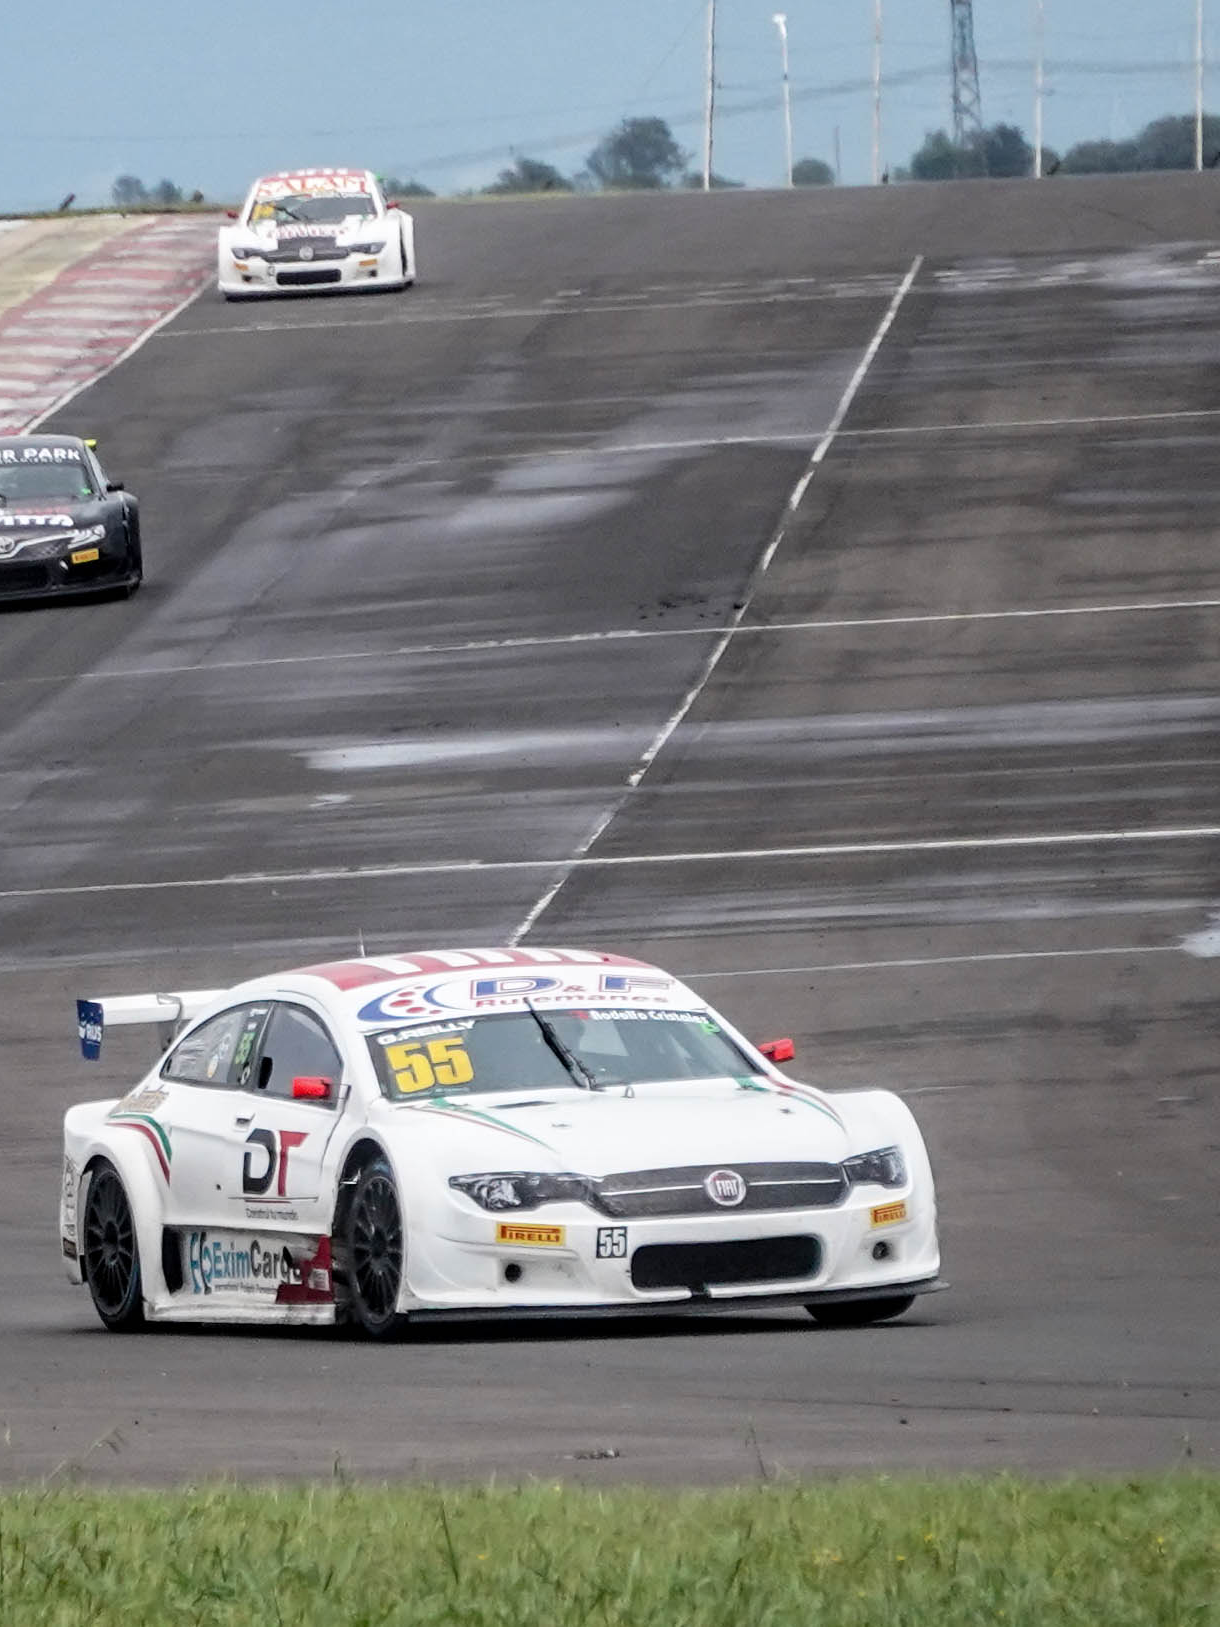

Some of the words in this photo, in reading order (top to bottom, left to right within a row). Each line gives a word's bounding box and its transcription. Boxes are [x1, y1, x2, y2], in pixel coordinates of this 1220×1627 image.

[23, 447, 81, 461] PARK
[475, 994, 669, 1009] Ruemanes
[590, 1010, 647, 1021] Rodolfo
[385, 1036, 475, 1094] 55
[717, 1178, 739, 1197] FIAT
[873, 1203, 907, 1225] PIRELLI
[500, 1225, 561, 1244] PIRELLI
[598, 1227, 626, 1257] 55
